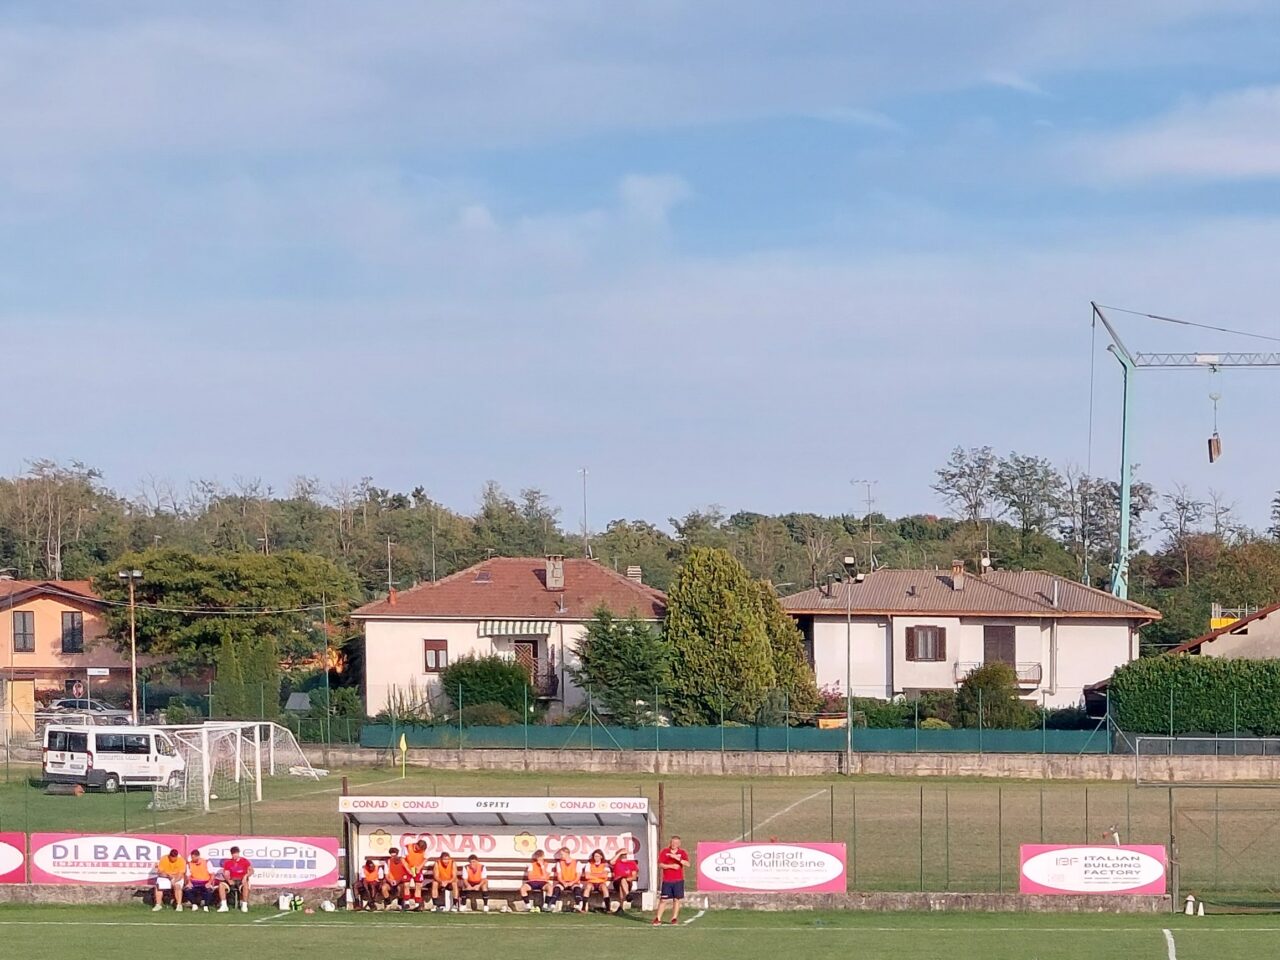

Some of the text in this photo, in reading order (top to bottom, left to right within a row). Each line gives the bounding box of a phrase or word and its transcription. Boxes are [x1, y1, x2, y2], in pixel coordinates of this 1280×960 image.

[352, 800, 439, 809] CONAD CONAD
[476, 801, 509, 809] OSPITI
[560, 801, 646, 810] CONAD CONAD
[399, 833, 497, 853] CONAD
[544, 834, 641, 854] CONAD
[53, 845, 162, 861] DI BARI
[208, 846, 317, 858] aredoPiù
[751, 850, 804, 860] Galstaff
[751, 859, 826, 868] MultiResine
[1055, 857, 1079, 866] IBF
